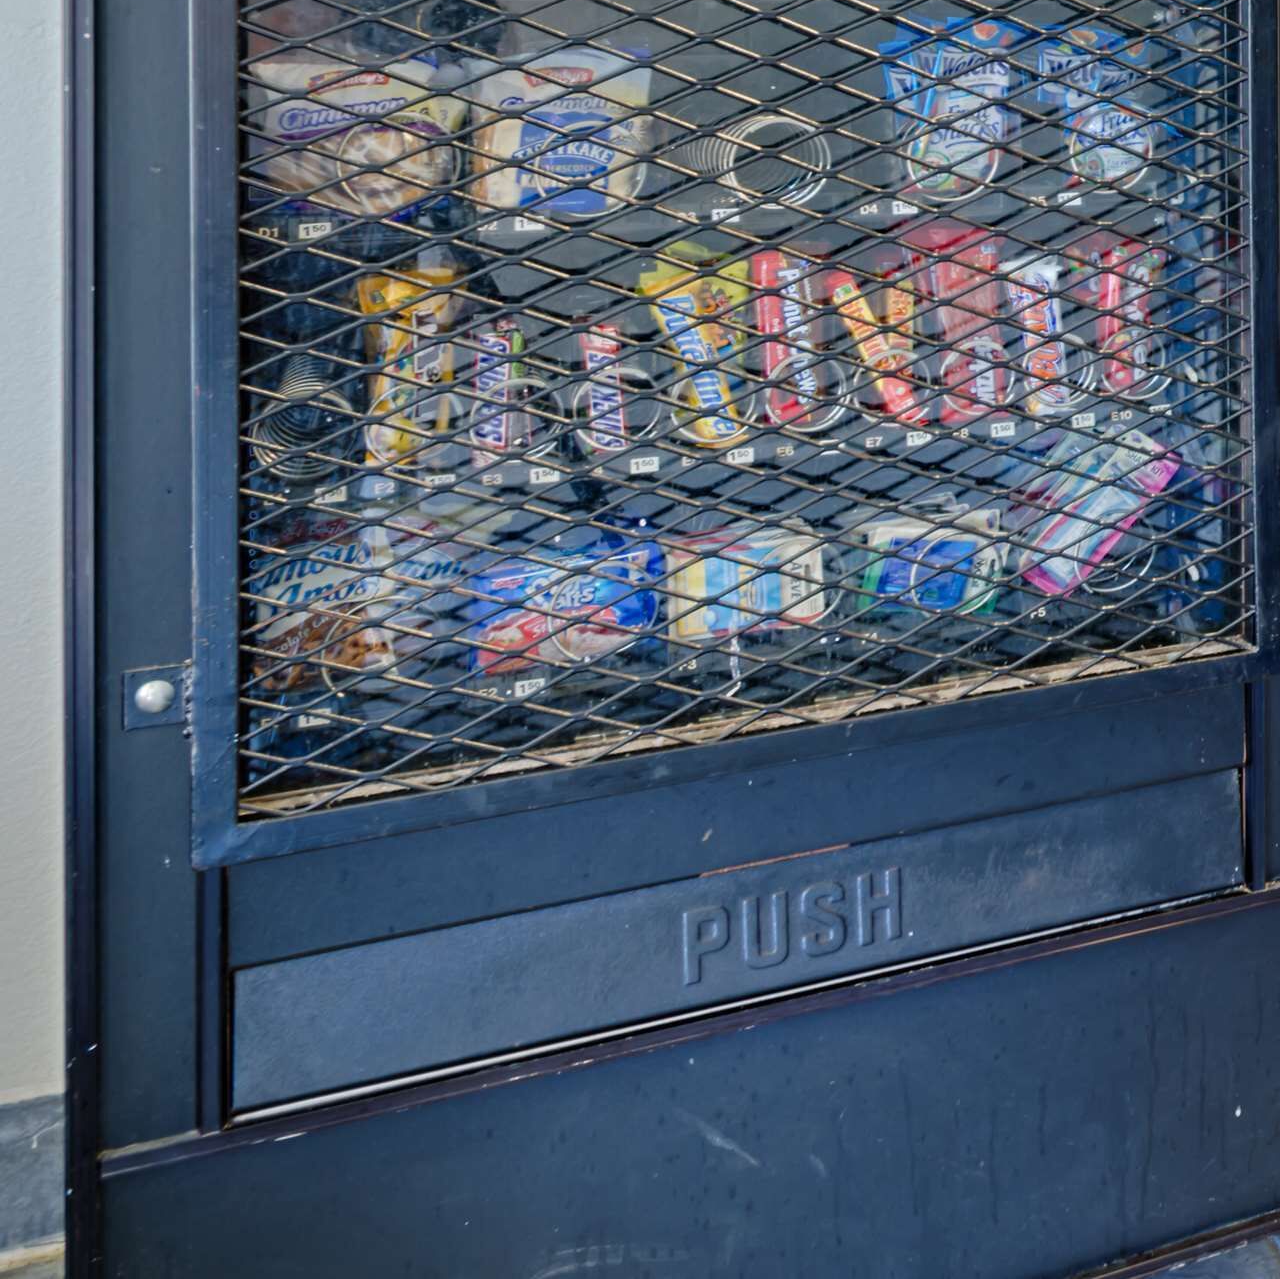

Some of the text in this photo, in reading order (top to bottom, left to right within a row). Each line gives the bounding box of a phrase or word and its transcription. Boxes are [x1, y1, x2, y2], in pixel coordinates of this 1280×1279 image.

[1111, 410, 1133, 421] E10
[865, 437, 884, 448] E7
[374, 480, 396, 493] E2
[682, 866, 905, 987] PUSH
